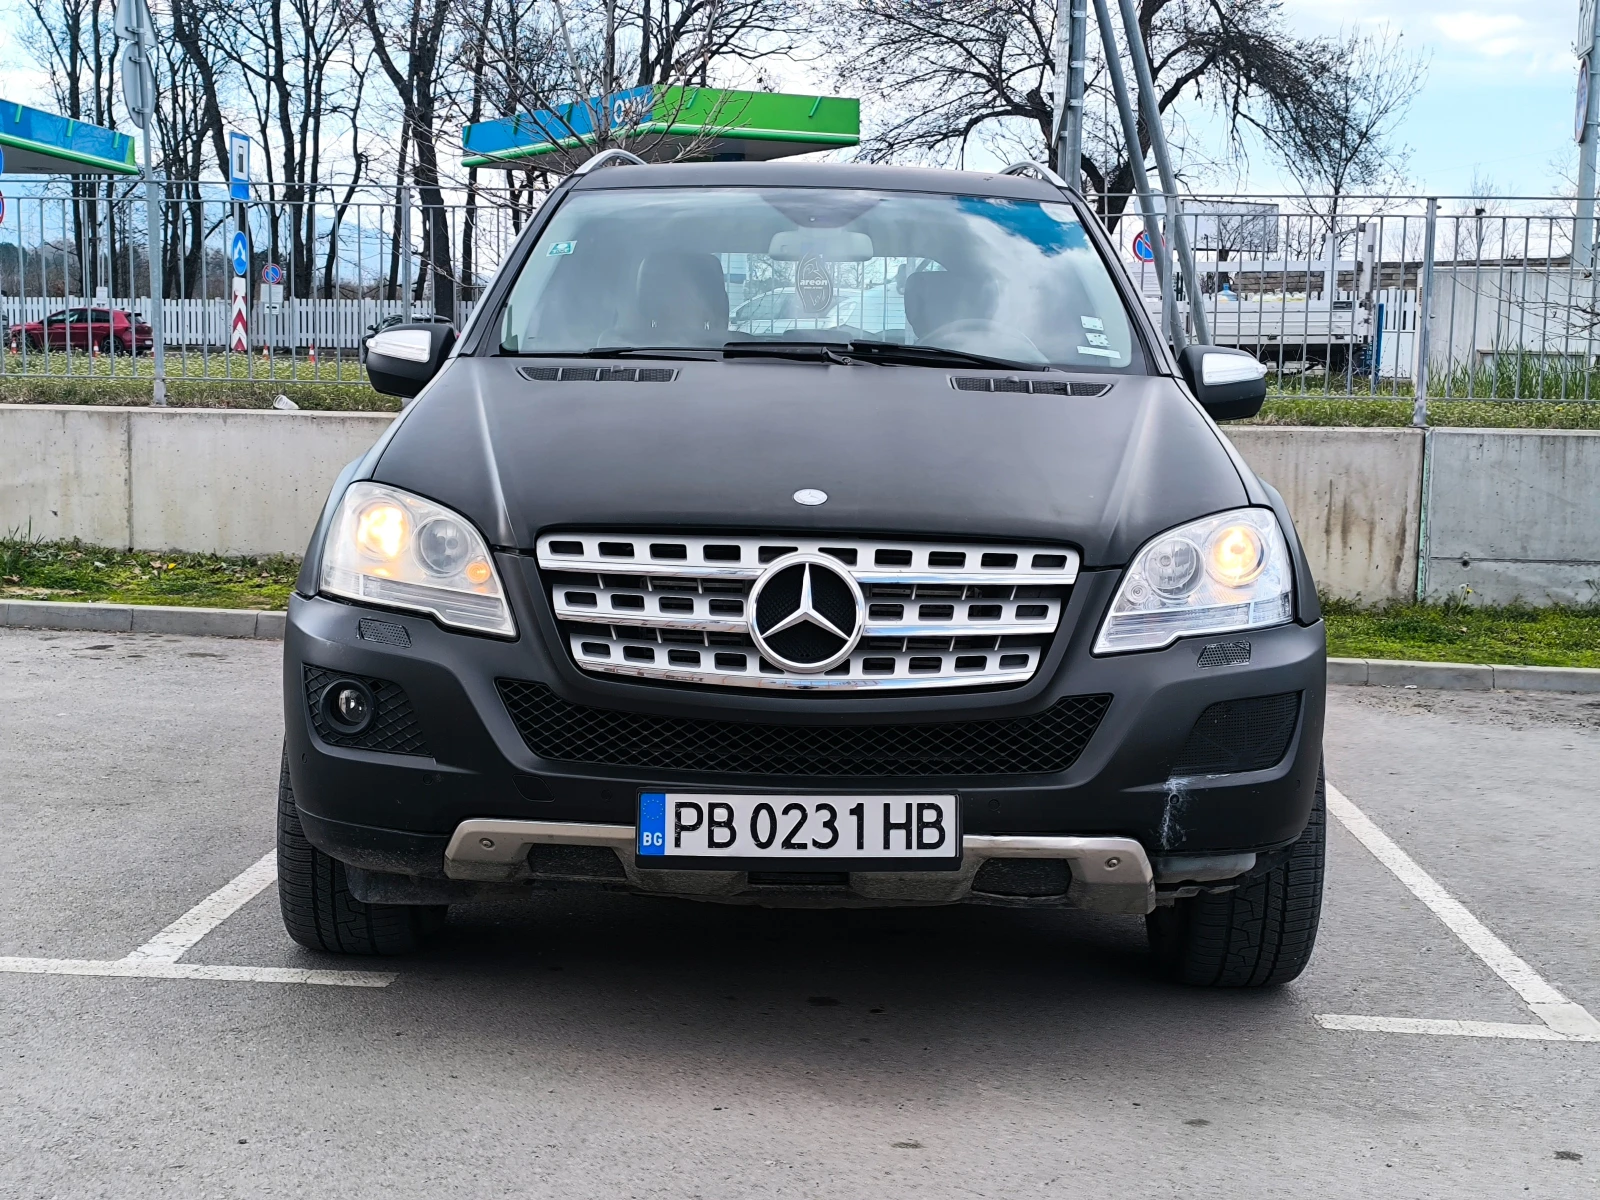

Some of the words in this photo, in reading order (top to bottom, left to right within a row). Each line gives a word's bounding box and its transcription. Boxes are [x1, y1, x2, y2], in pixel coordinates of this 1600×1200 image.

[642, 832, 663, 847] BG
[674, 801, 737, 849] PB
[749, 802, 864, 850] 0231
[882, 802, 946, 850] HB
